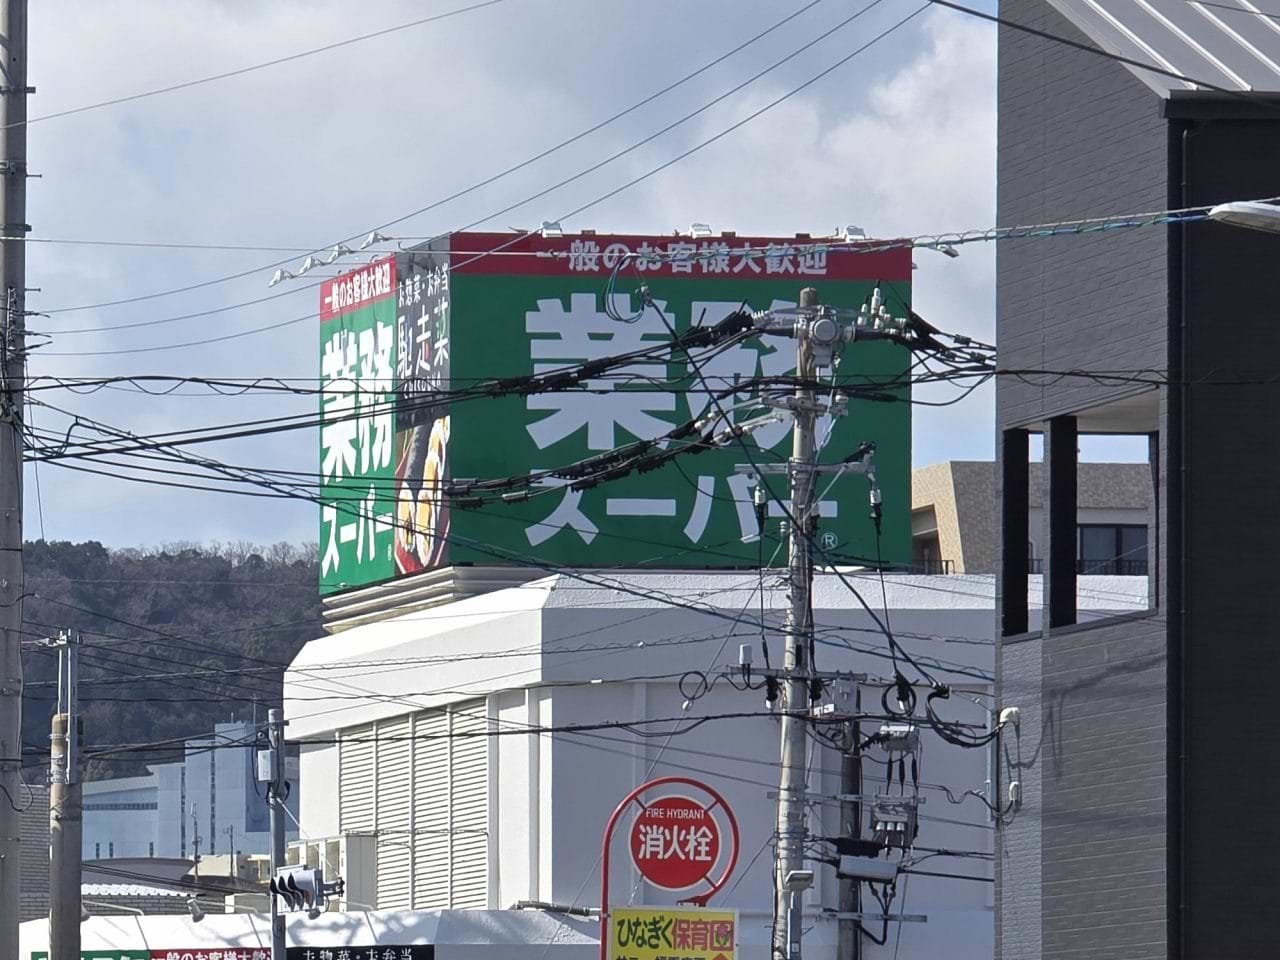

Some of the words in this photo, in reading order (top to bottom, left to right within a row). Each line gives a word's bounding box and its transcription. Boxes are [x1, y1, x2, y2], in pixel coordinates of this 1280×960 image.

[536, 240, 827, 275] 一般のお客様大歓迎
[322, 322, 394, 486] 業務
[525, 293, 833, 452] 業務
[322, 484, 394, 579] スーパー
[525, 469, 838, 546] スーパー
[638, 824, 713, 861] 消火栓
[646, 807, 664, 818] FIRE
[667, 808, 705, 819] HYDRANT
